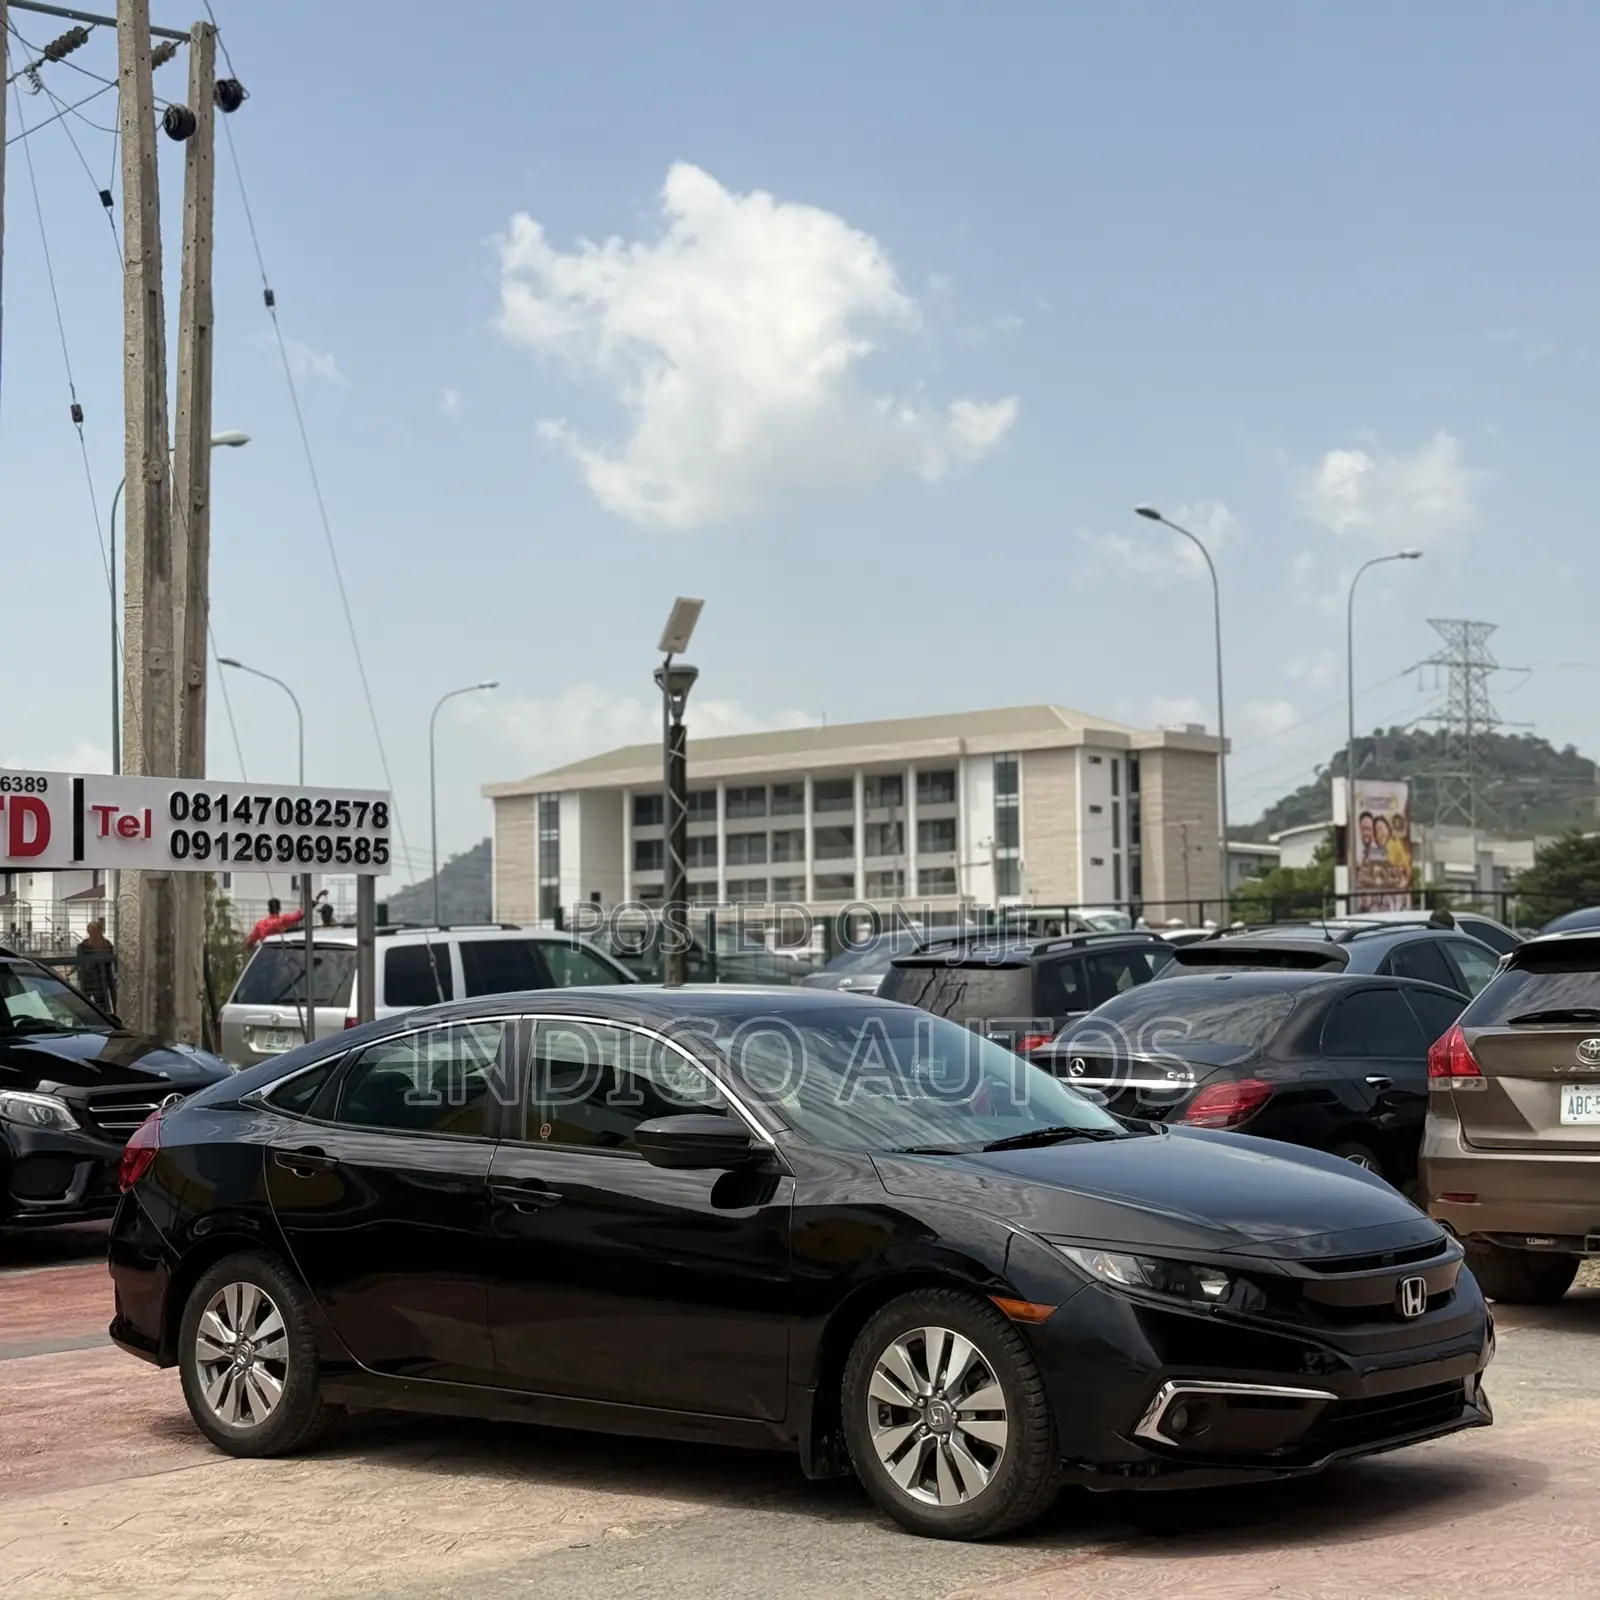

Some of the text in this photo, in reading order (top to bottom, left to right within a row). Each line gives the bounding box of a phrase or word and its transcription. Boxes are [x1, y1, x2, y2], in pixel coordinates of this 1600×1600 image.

[0, 795, 51, 857] D
[91, 805, 152, 839] Tel
[169, 791, 389, 829] 08147082578
[169, 829, 390, 866] 09126969585
